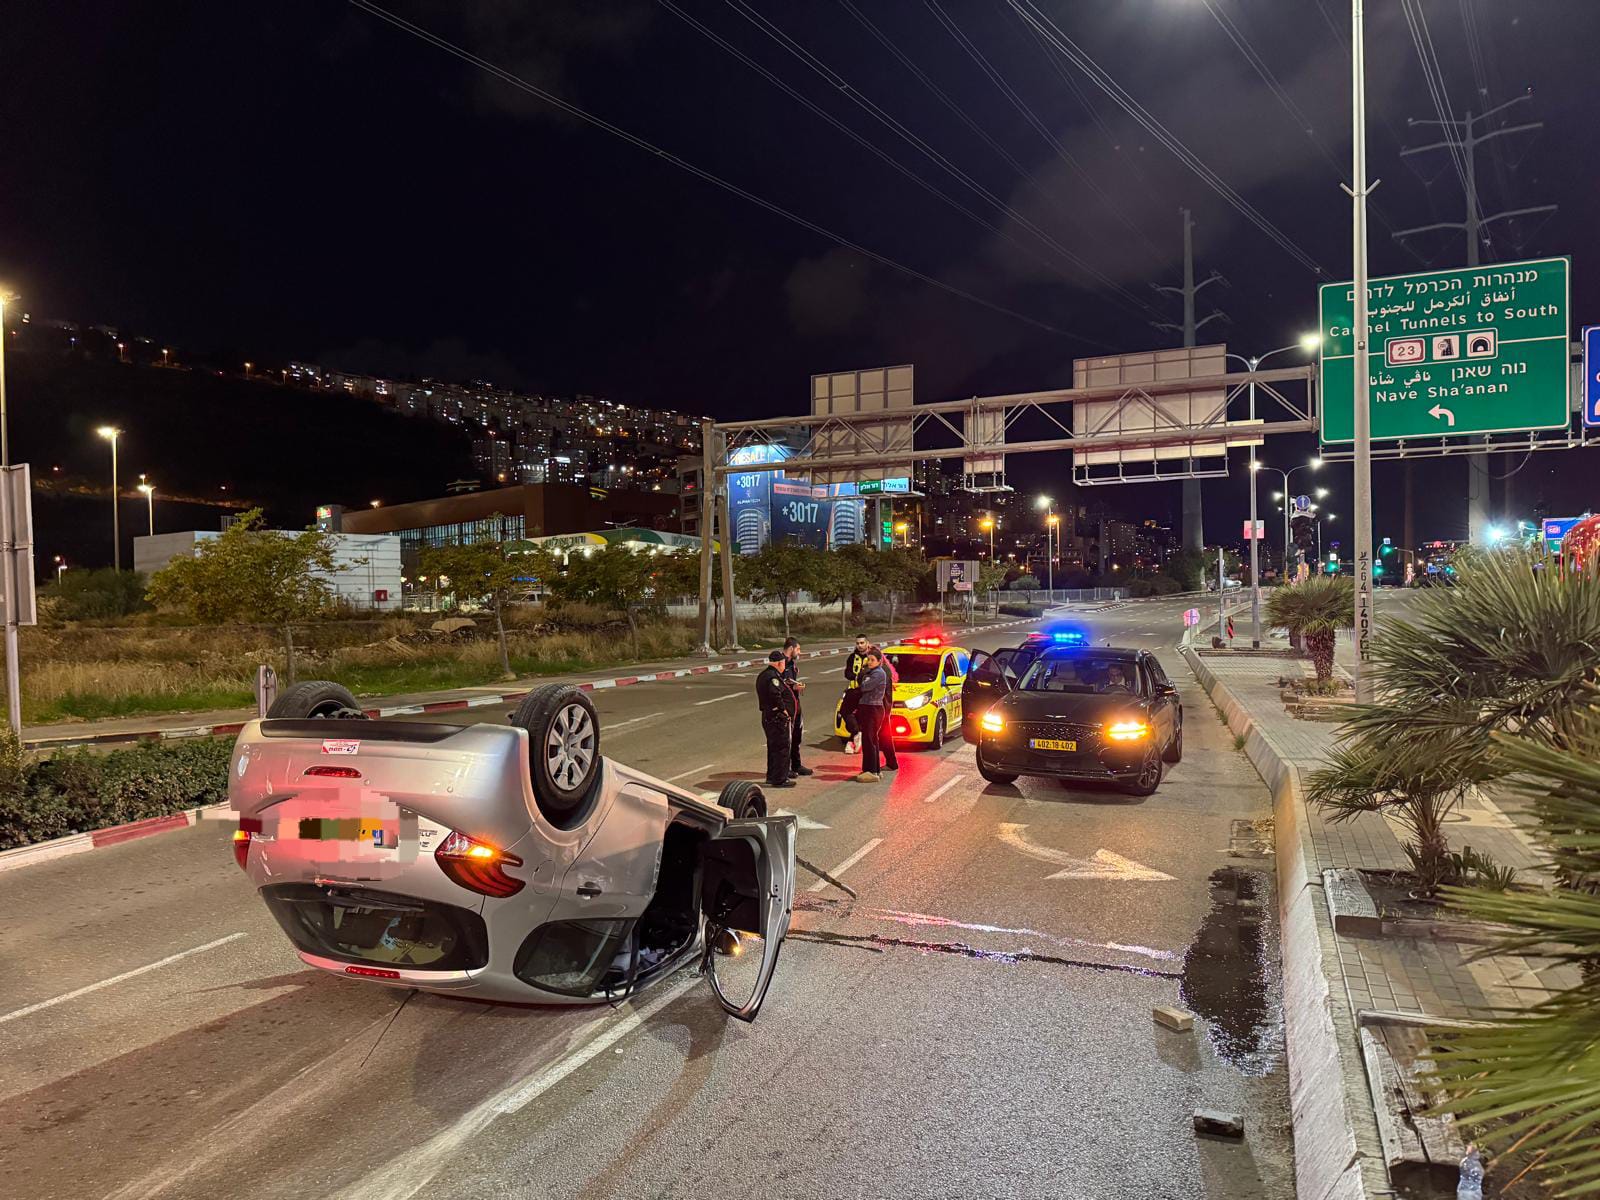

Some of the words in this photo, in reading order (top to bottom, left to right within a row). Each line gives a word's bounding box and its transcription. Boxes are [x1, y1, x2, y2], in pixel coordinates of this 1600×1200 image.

[1404, 278, 1462, 296] הכרמל
[1473, 270, 1539, 289] מנהרות
[1346, 283, 1395, 302] לדרם
[1329, 321, 1391, 337] Cael
[1400, 314, 1467, 330] Tunnels
[1477, 311, 1495, 323] to
[1504, 303, 1559, 320] South
[1397, 345, 1415, 357] 23
[1451, 364, 1492, 382] שאנן
[1501, 362, 1527, 375] נוה
[1376, 390, 1418, 403] Nave
[1428, 383, 1509, 398] Sha'anan
